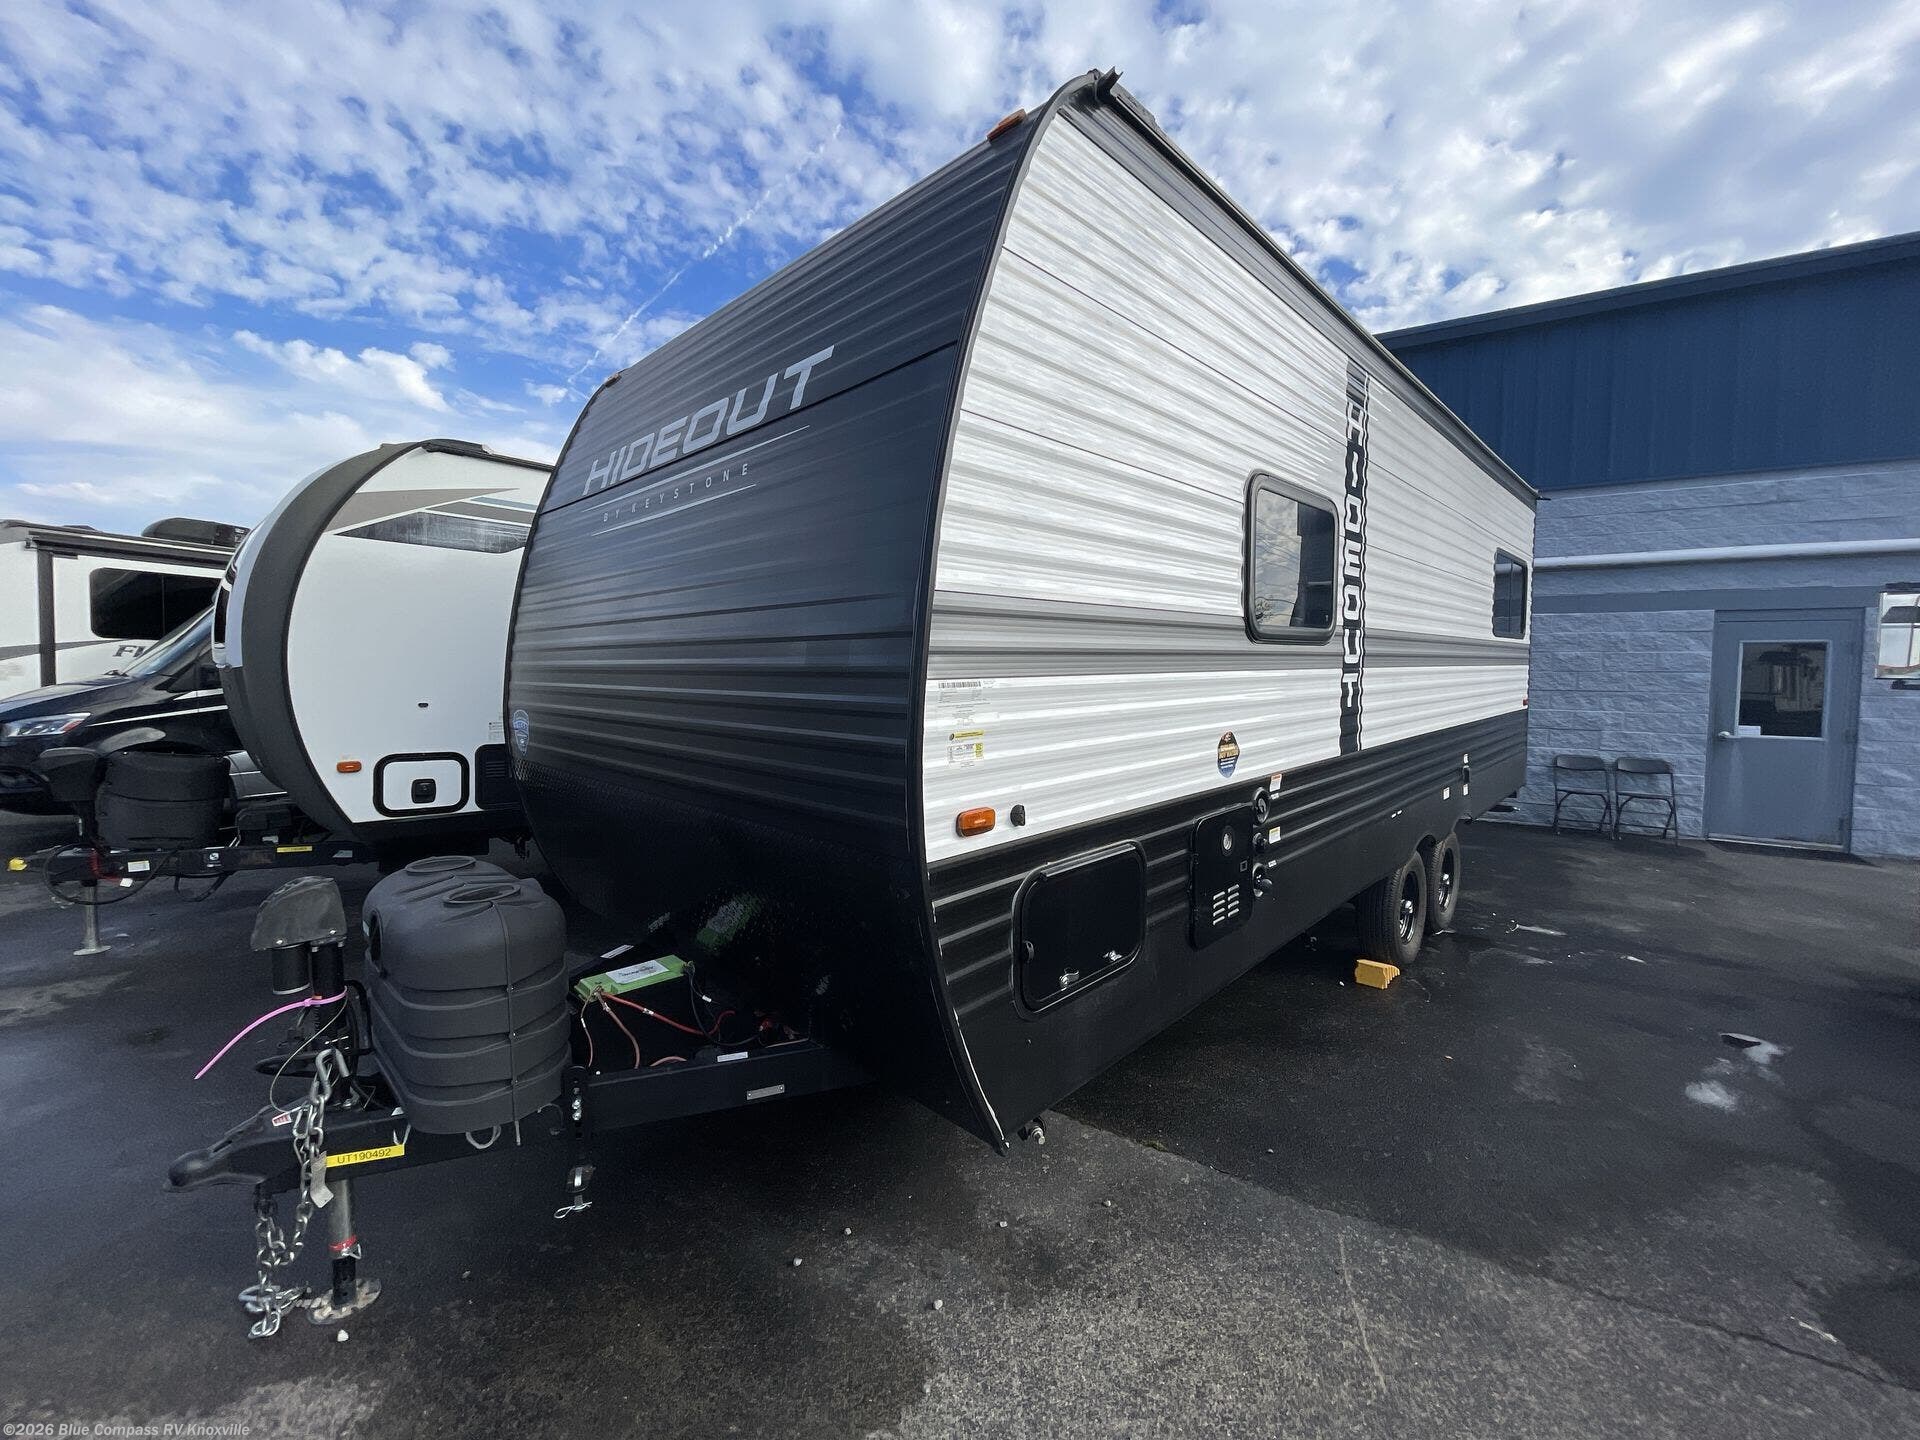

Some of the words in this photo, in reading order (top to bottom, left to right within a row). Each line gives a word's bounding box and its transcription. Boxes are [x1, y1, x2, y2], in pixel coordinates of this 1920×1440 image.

[582, 345, 834, 496] HIDEOUT
[603, 509, 620, 522] BY
[632, 463, 748, 513] KEYSTONE
[1343, 401, 1364, 708] HIDEOUT
[337, 1148, 392, 1164] UT190492
